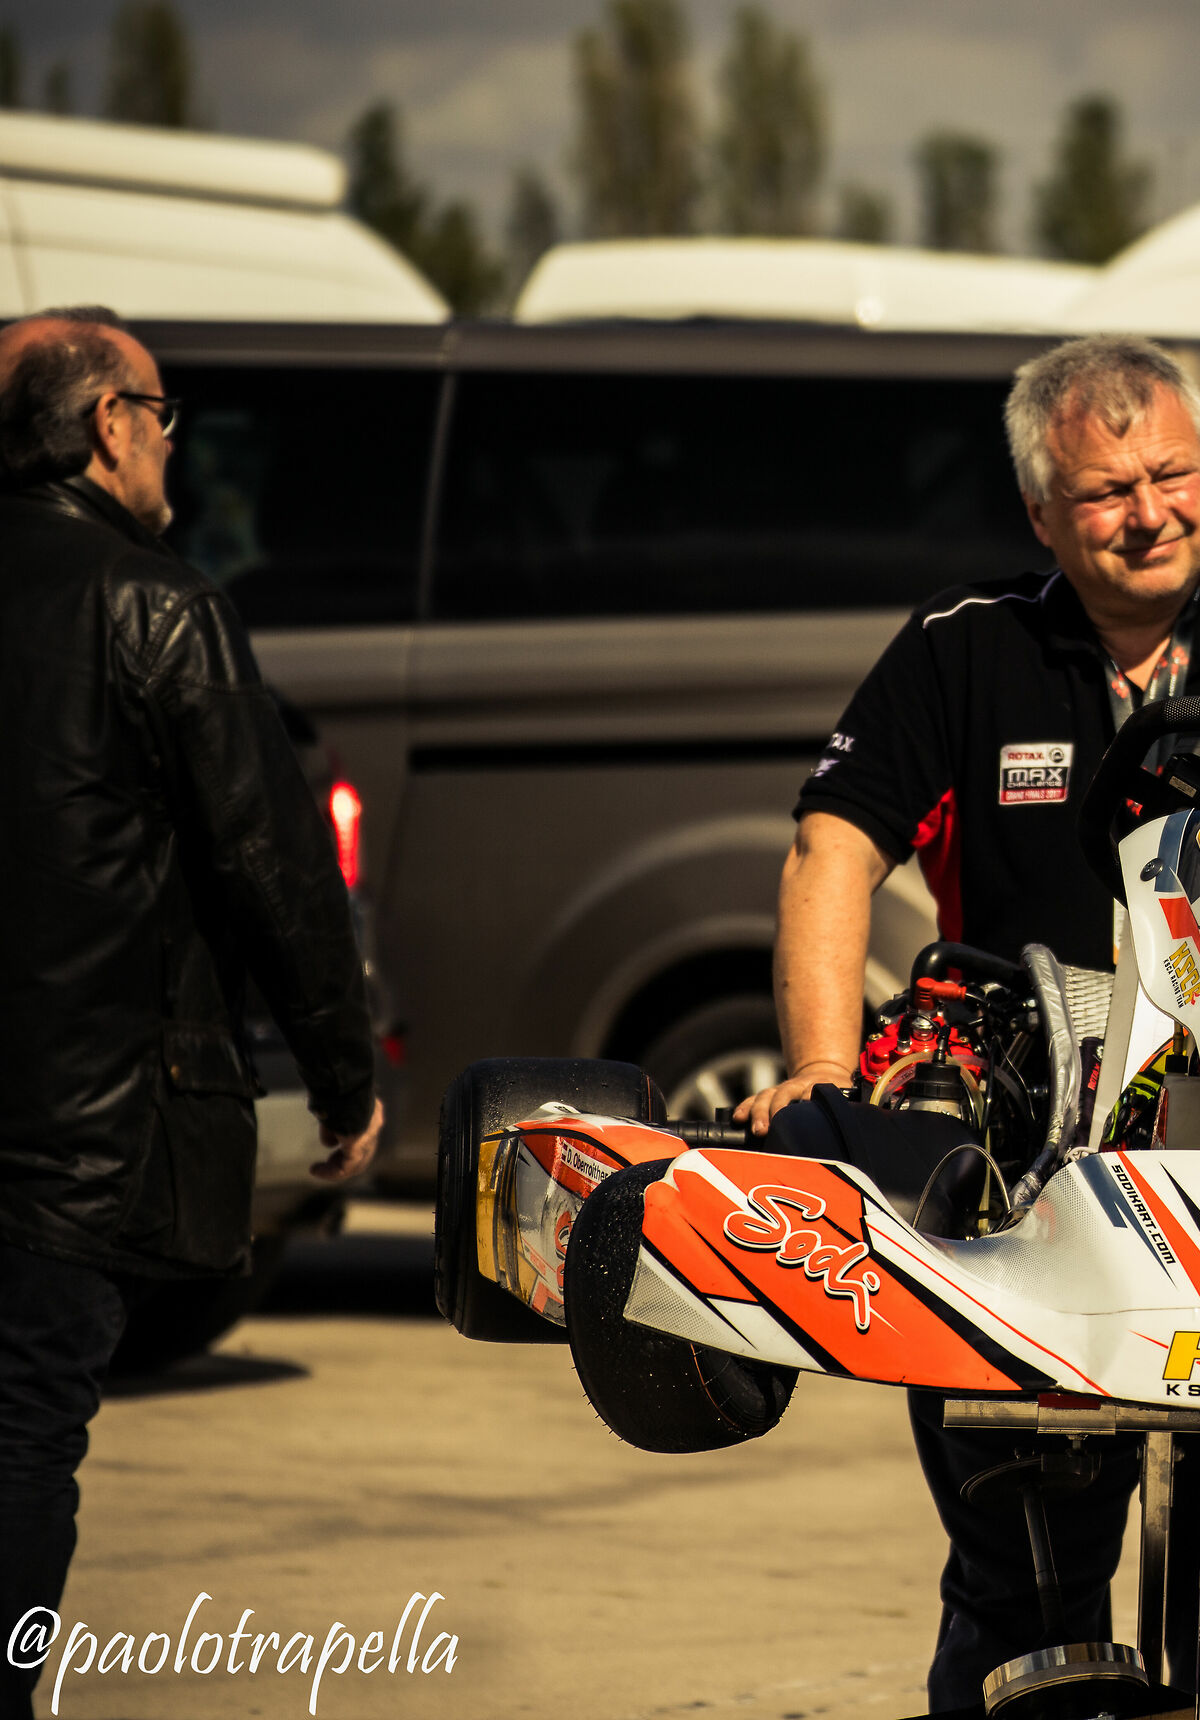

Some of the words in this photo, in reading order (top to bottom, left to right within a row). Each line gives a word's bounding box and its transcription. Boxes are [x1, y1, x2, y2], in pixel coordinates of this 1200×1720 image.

[1007, 752, 1044, 761] ROTAX
[1007, 768, 1063, 782] MAX
[1111, 1164, 1176, 1265] SODIKART.COM
[724, 1184, 881, 1335] Sodi
